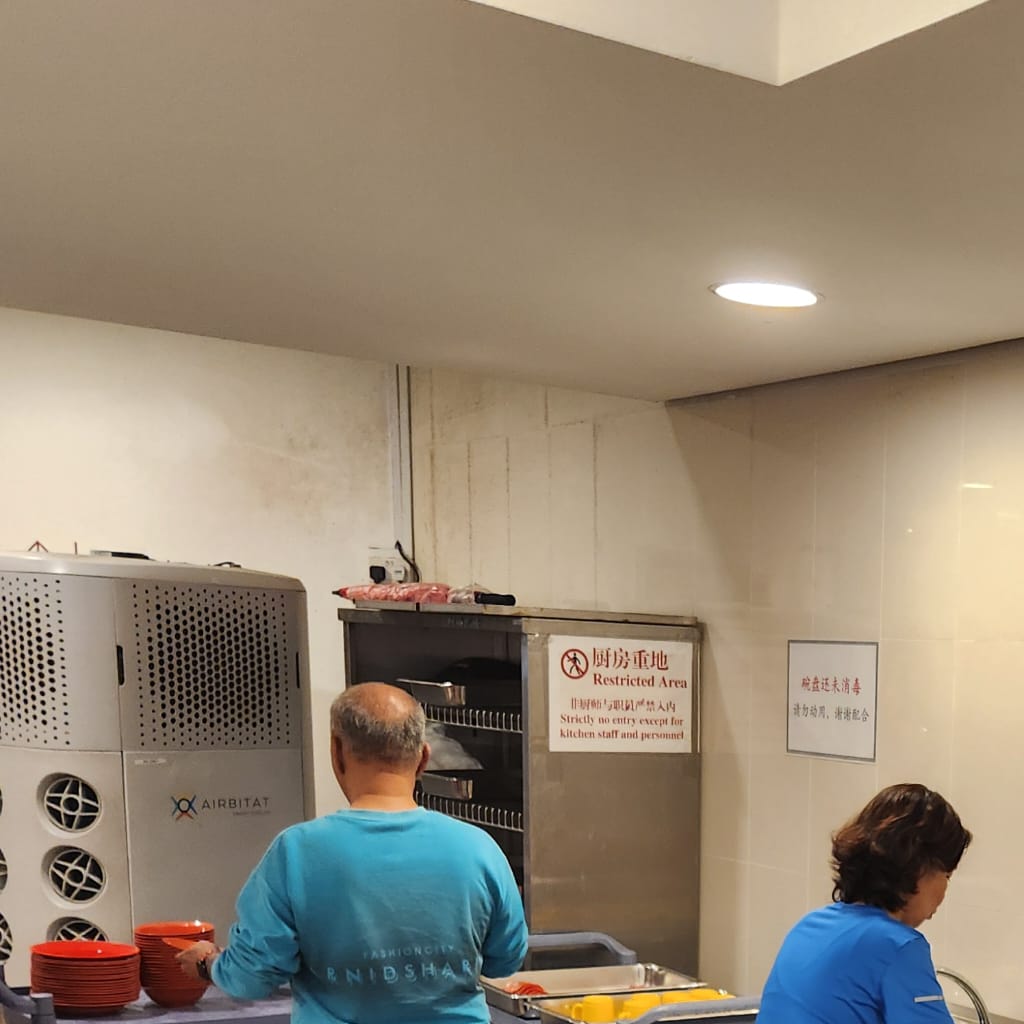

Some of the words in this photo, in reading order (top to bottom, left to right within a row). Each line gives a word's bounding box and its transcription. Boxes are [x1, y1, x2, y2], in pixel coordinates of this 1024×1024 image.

[592, 647, 669, 671] 厨房重地
[593, 673, 655, 688] Restricted
[658, 675, 687, 689] Area
[801, 675, 862, 696] 碗盘还未消毒
[560, 714, 595, 726] Strictly
[598, 716, 610, 725] no
[612, 717, 637, 728] entry
[639, 717, 668, 728] except
[670, 716, 684, 727] for
[560, 729, 595, 739] kitchen
[598, 729, 619, 739] staff
[621, 730, 638, 740] and
[641, 731, 684, 742] personnel
[201, 797, 270, 810] AIRBITAT
[363, 944, 454, 960] FASHIONCITY
